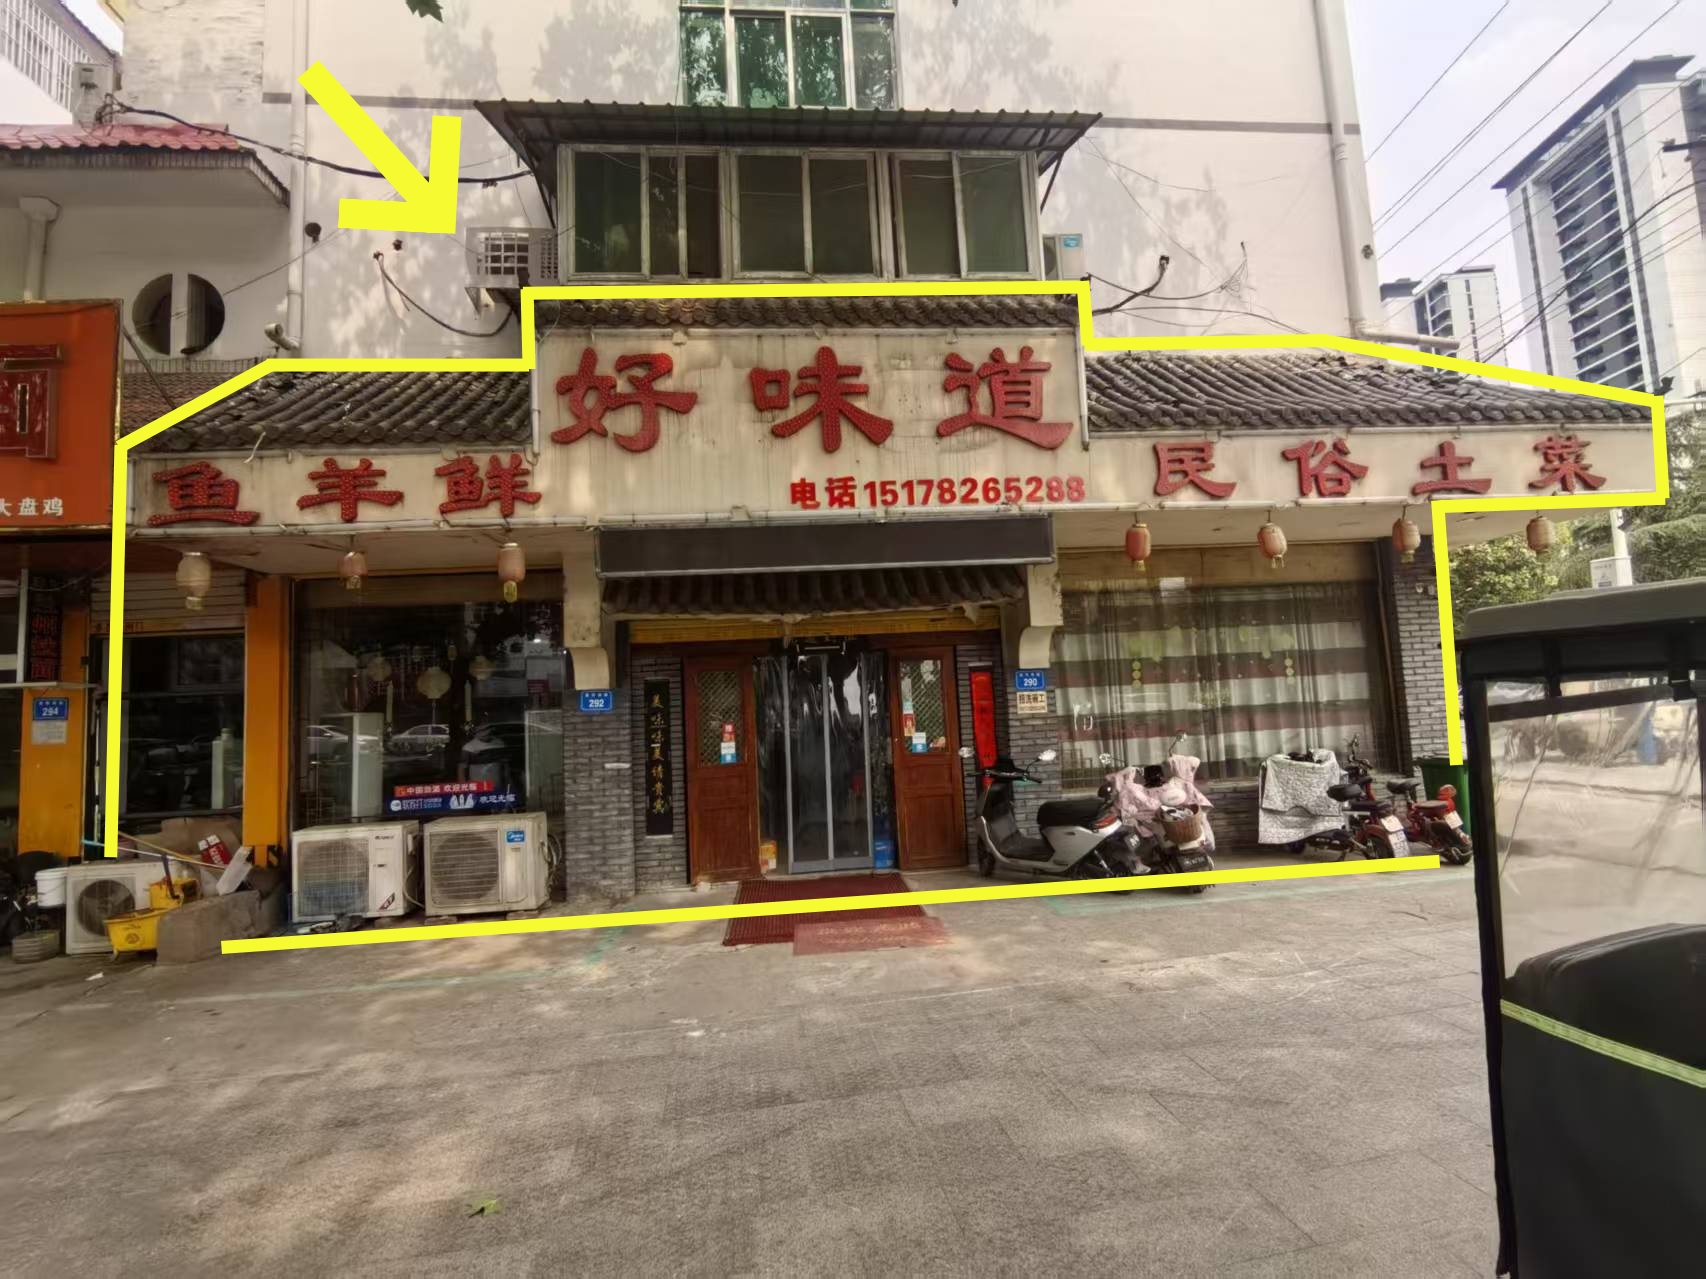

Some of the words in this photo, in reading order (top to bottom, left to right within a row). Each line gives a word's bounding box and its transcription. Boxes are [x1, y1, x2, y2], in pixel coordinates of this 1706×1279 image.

[550, 345, 1075, 455] 好味道
[1152, 433, 1608, 499] 民俗土菜
[148, 452, 543, 527] 鱼羊鲜
[1023, 678, 1038, 687] 290
[42, 706, 59, 717] 294
[588, 698, 605, 708] 292
